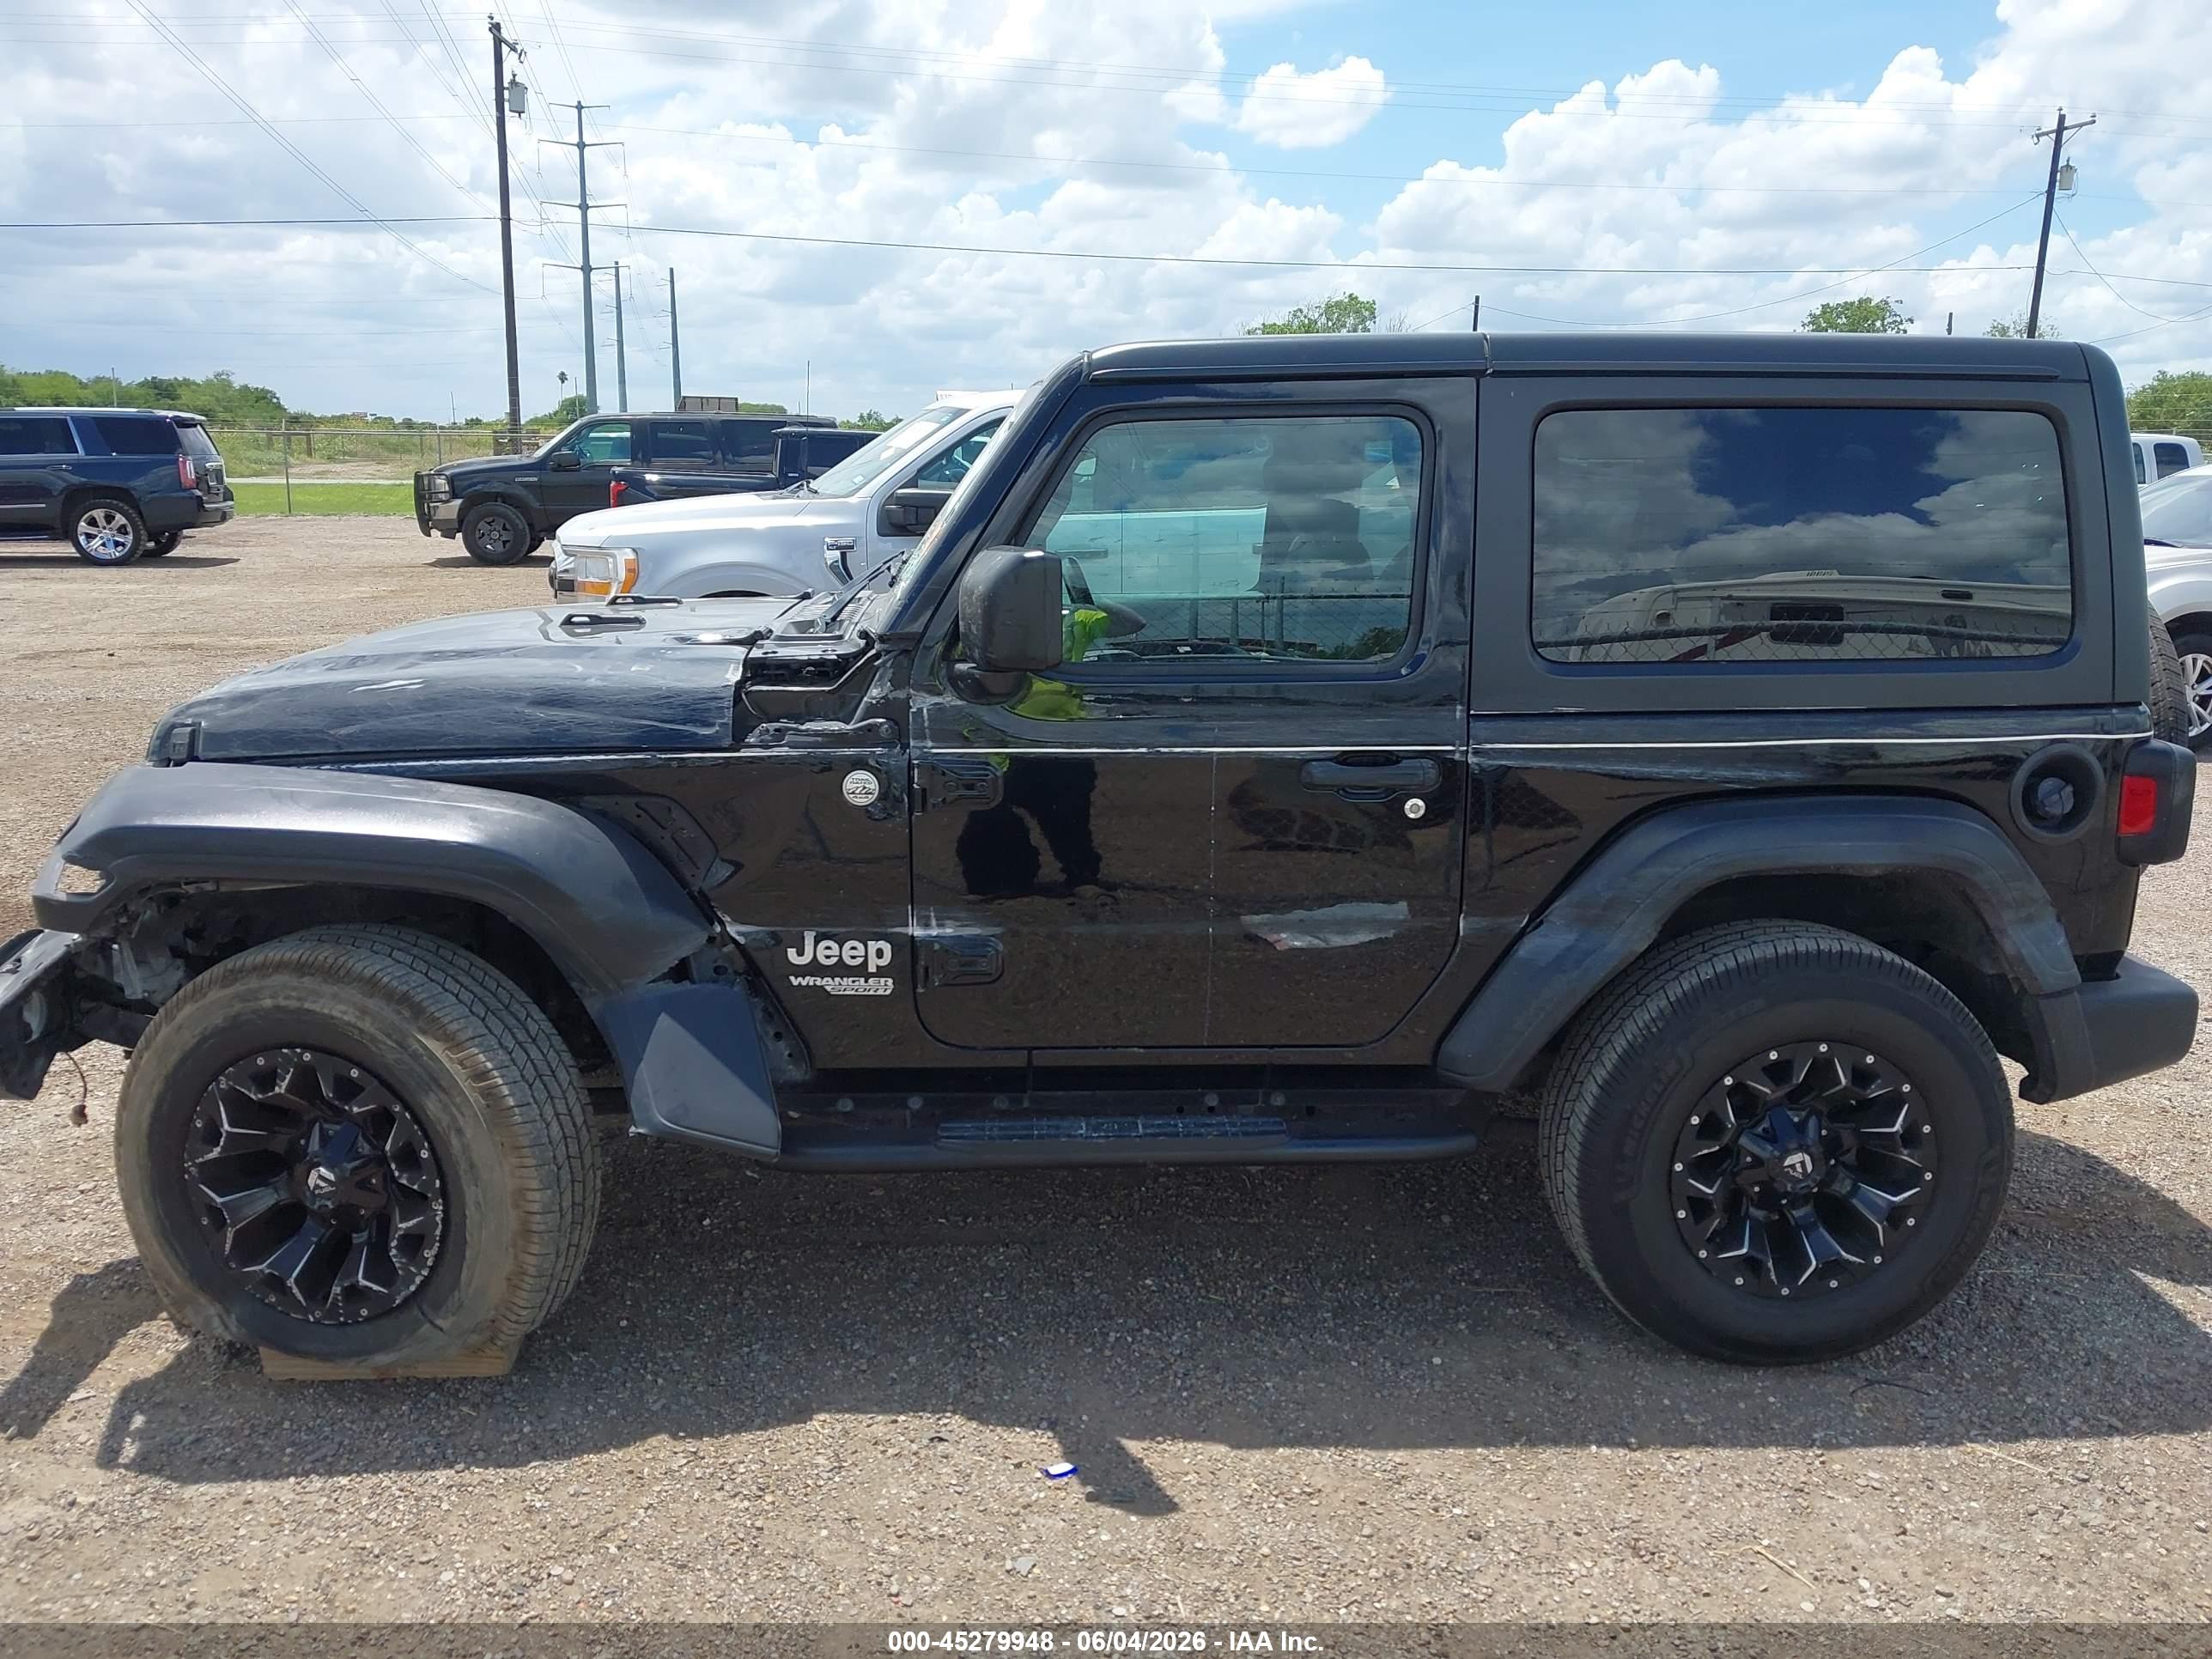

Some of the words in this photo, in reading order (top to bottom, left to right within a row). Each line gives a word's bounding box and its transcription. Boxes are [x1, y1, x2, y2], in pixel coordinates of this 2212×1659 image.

[786, 930, 892, 973] Jeep
[788, 975, 894, 987] WRANGLER
[828, 986, 892, 994] SPORT
